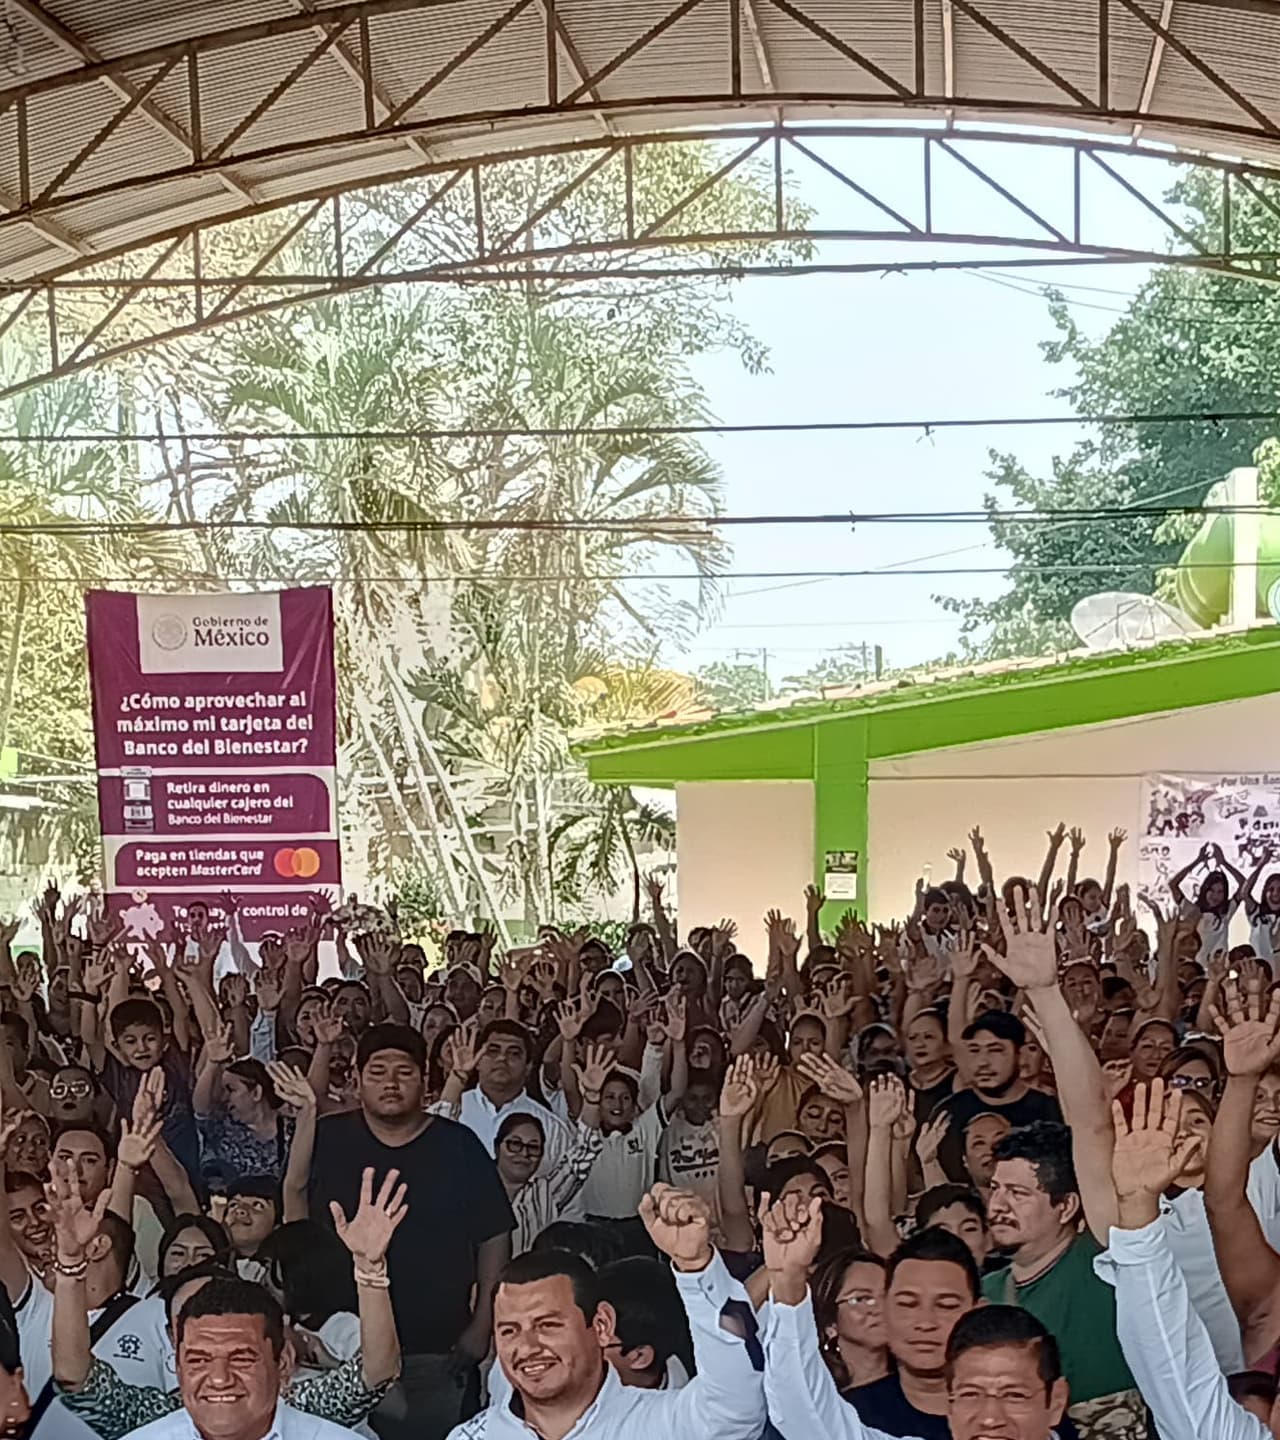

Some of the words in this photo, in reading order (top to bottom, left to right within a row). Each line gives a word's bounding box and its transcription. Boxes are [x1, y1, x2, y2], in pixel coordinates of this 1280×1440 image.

[192, 616, 251, 628] Gobierno
[254, 616, 269, 627] de
[193, 628, 270, 647] México
[120, 692, 180, 712] ¿Cómo
[184, 691, 286, 713] aprovechar
[289, 690, 307, 707] al
[116, 715, 190, 733] máximo
[192, 716, 216, 732] mi
[220, 714, 282, 735] tarjeta
[286, 713, 313, 730] del
[123, 739, 178, 756] Banco
[182, 738, 210, 755] del
[213, 737, 309, 756] Bienestar?
[167, 782, 206, 794] Retira
[209, 782, 251, 794] dinero
[253, 782, 270, 793] en
[167, 797, 228, 811] cualquier
[231, 796, 271, 812] cajero
[273, 795, 294, 808] del
[168, 813, 202, 825] Banco
[203, 813, 221, 824] del
[223, 813, 273, 825] Bienestar
[135, 849, 167, 864] Paga
[170, 850, 186, 861] en
[188, 848, 237, 861] tiendas
[239, 850, 264, 862] que
[136, 864, 188, 879] acepten
[190, 863, 263, 876] MasterCard
[242, 904, 289, 918] control
[291, 903, 309, 917] de
